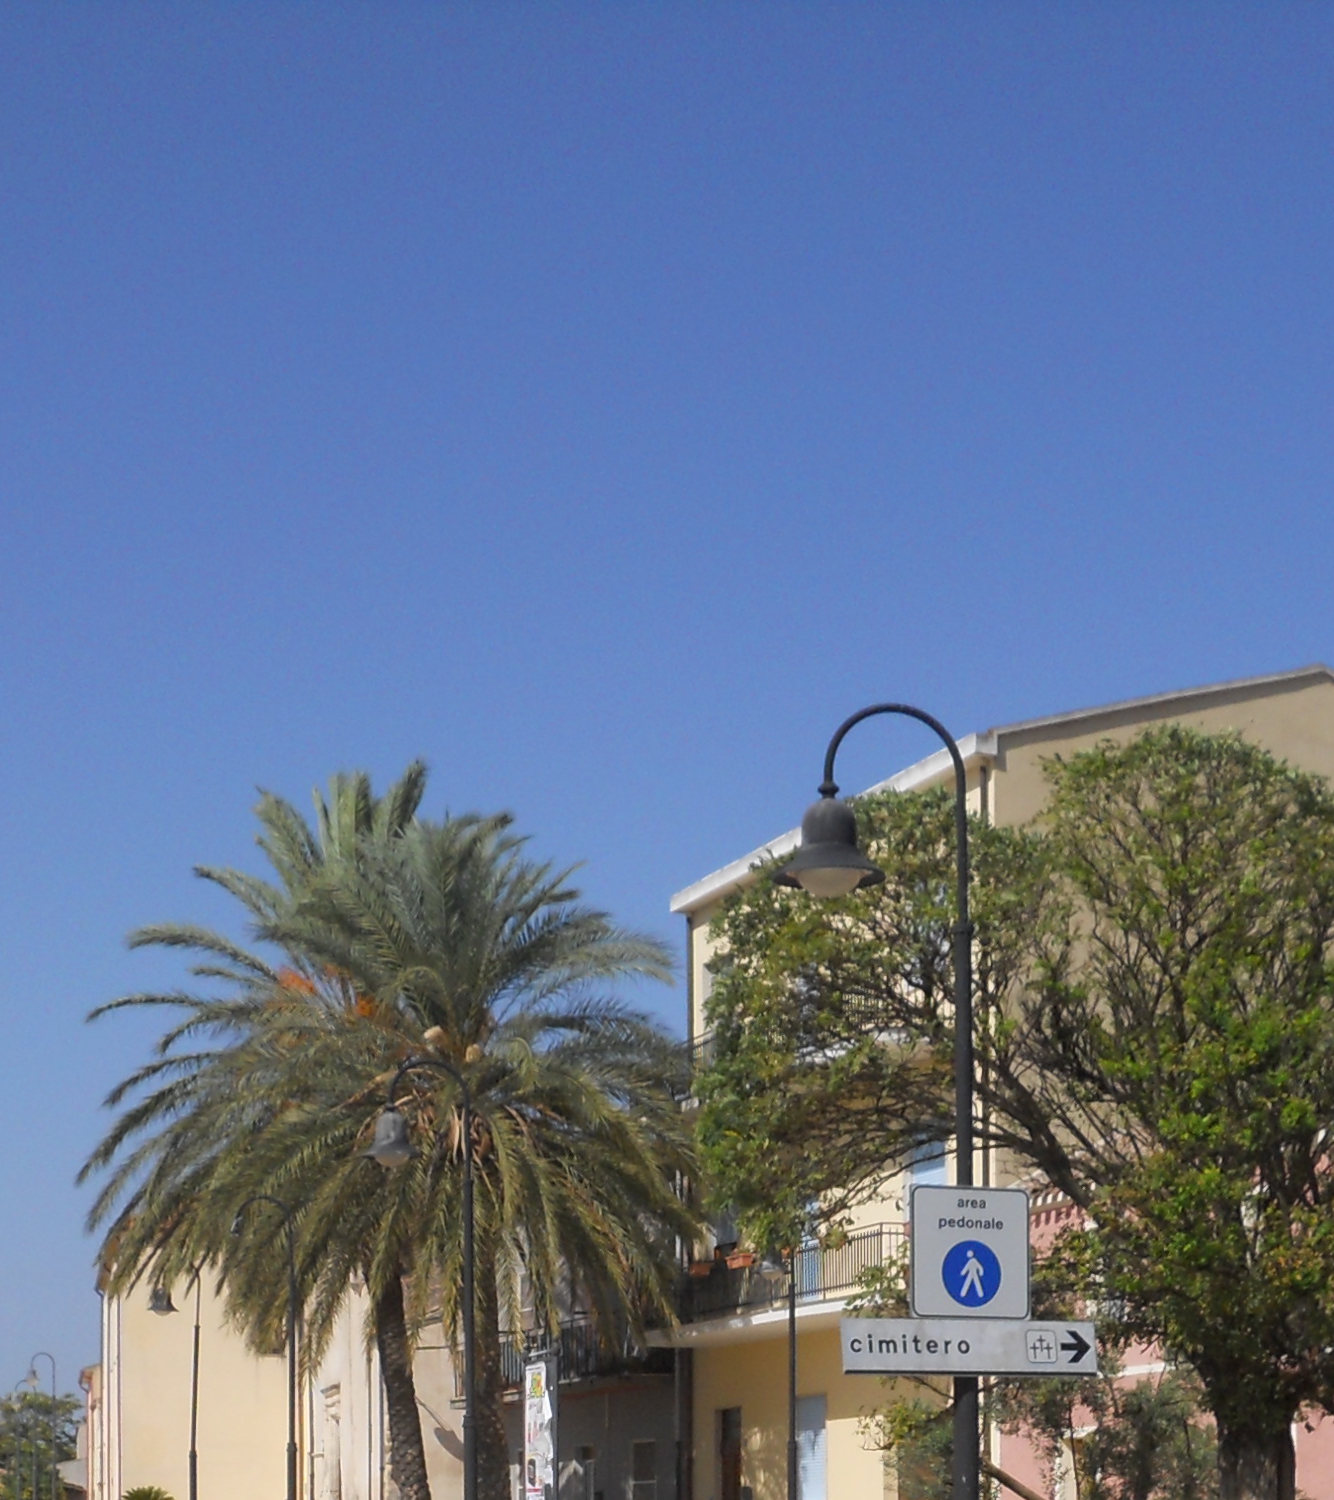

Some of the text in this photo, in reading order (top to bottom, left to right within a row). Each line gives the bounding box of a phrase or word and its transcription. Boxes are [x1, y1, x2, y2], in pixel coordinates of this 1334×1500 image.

[957, 1197, 987, 1209] area
[938, 1216, 1004, 1230] pedonale
[850, 1333, 971, 1355] cimitero
